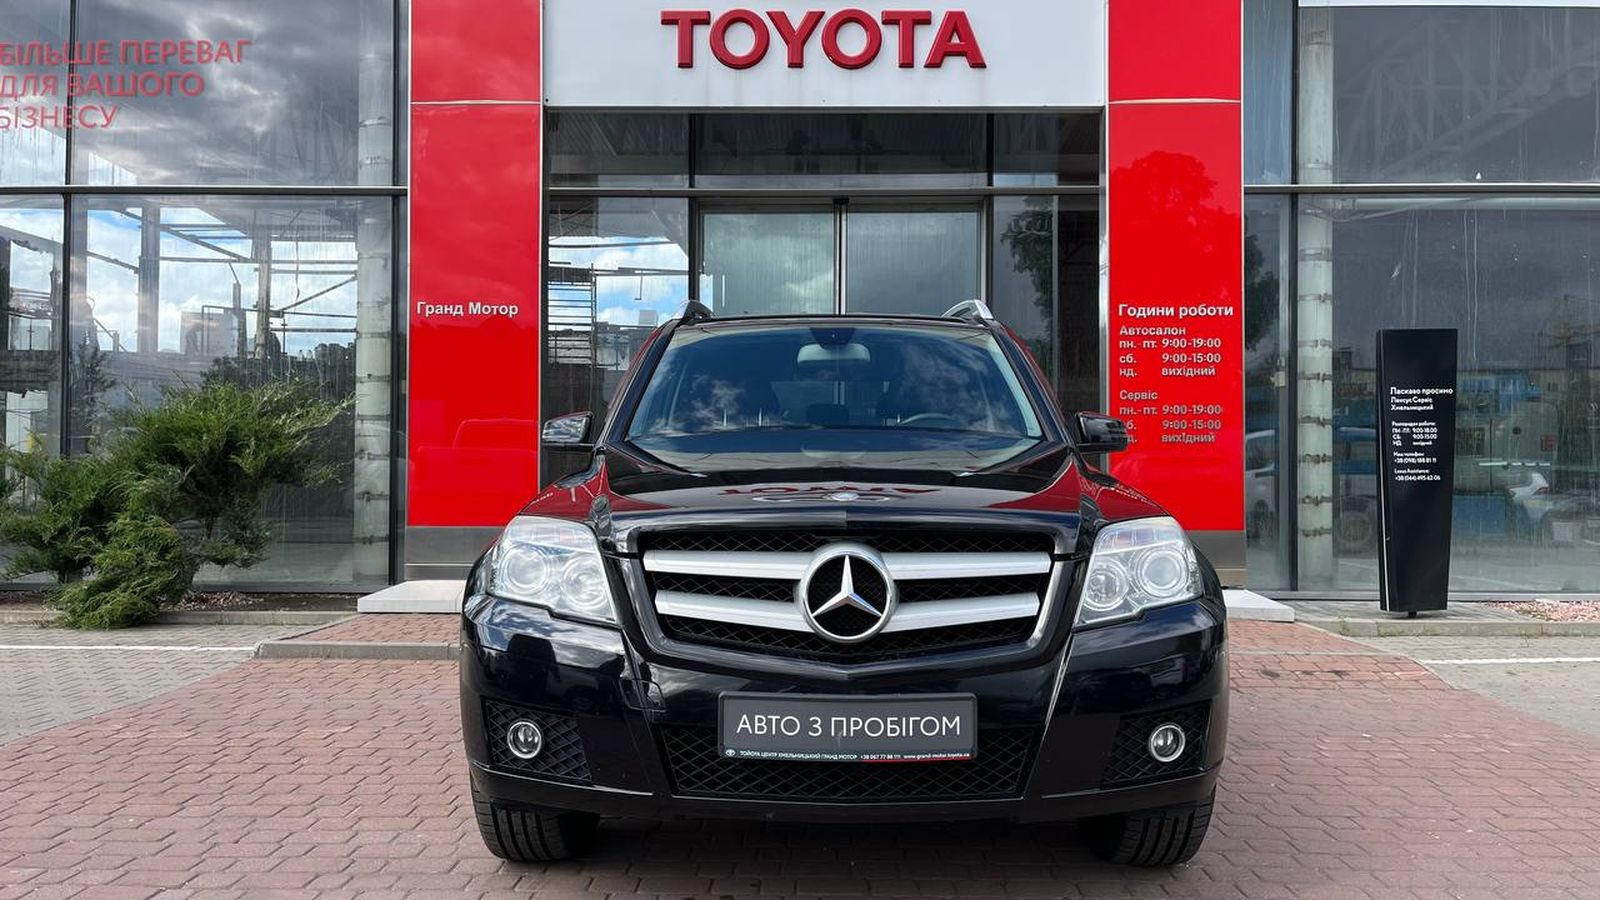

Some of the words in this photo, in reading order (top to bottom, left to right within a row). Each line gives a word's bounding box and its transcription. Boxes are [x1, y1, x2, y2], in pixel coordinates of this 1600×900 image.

[660, 8, 988, 70] TOYOTA
[0, 40, 114, 66] БІЛЬШЕ
[120, 39, 252, 65] ПЕРЕВАГ
[0, 74, 58, 101] ДЛЯ
[67, 72, 206, 97] ВАШОГО
[0, 105, 120, 128] БІЗНЕСУ
[417, 301, 464, 317] Гранд
[468, 301, 519, 318] Мотор
[1119, 304, 1175, 318] Години
[1179, 304, 1234, 319] роботи
[1119, 325, 1186, 336] Автосалон
[1119, 353, 1137, 363] сб.
[1119, 368, 1138, 377] нд.
[1161, 365, 1216, 377] вихідний
[1119, 389, 1159, 402] Сервіс
[1161, 432, 1215, 443] вихідний
[736, 714, 801, 737] АВТО
[807, 716, 823, 737] З
[831, 715, 961, 737] ПРОБІГОМ
